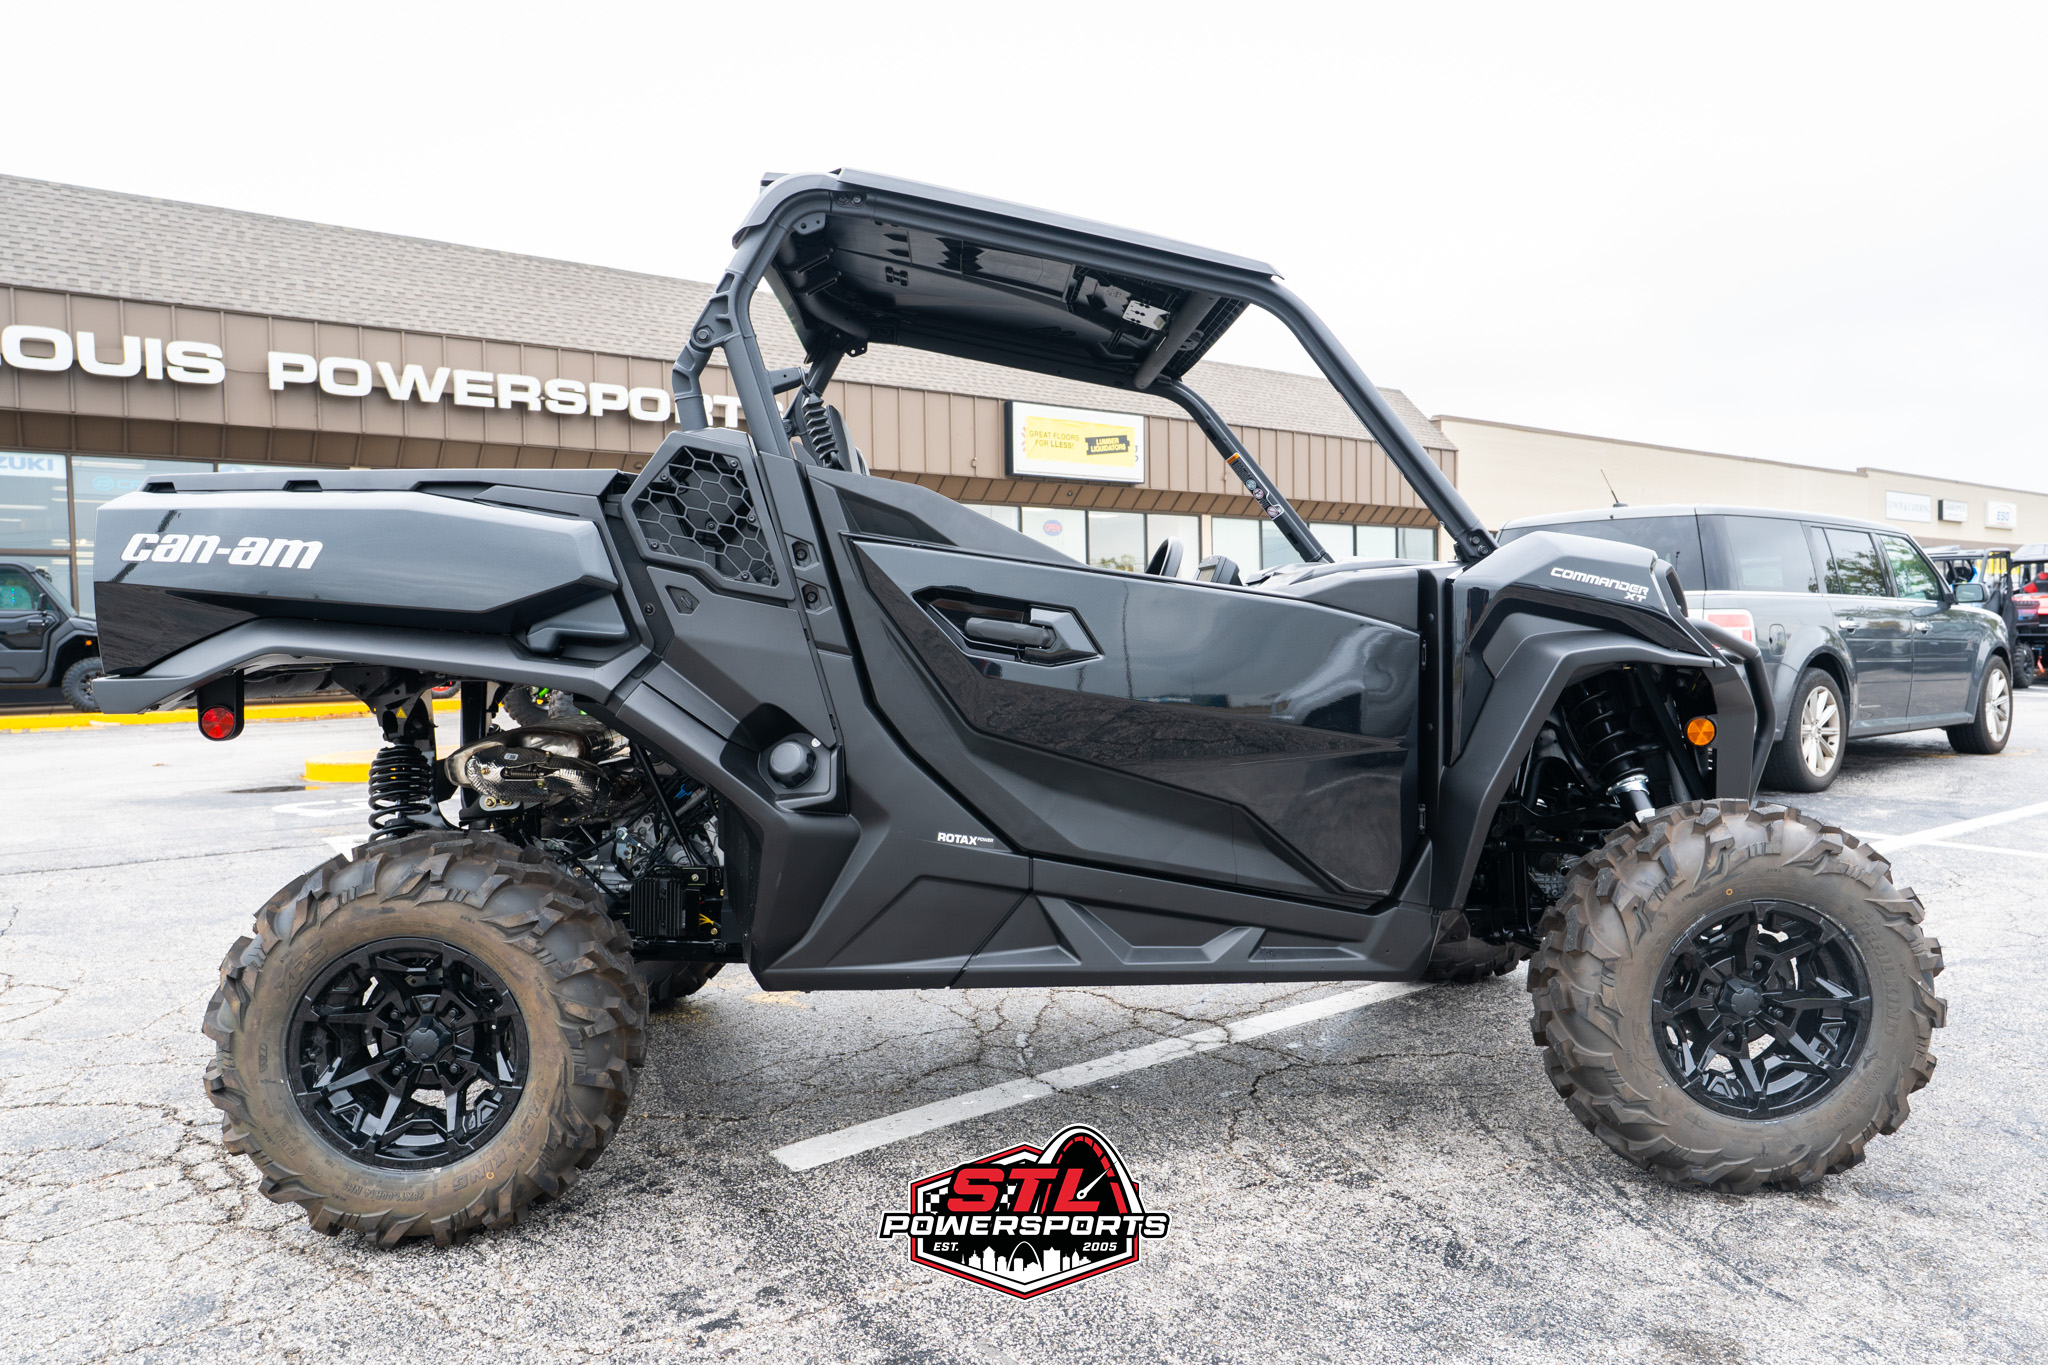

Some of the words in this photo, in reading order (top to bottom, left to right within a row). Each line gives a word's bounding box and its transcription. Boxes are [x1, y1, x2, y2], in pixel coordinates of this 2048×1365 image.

[0, 324, 226, 384] OUIS
[268, 351, 783, 429] POWERSPOT
[1029, 430, 1051, 438] GREAT
[1053, 432, 1079, 442] FLOORS
[1095, 437, 1119, 446] LUMBER
[1035, 439, 1048, 447] FOR
[1090, 443, 1126, 453] LIQUIDATORS
[1550, 566, 1649, 596] COMMANDER
[1624, 591, 1647, 602] XT
[937, 832, 978, 846] ROTAX
